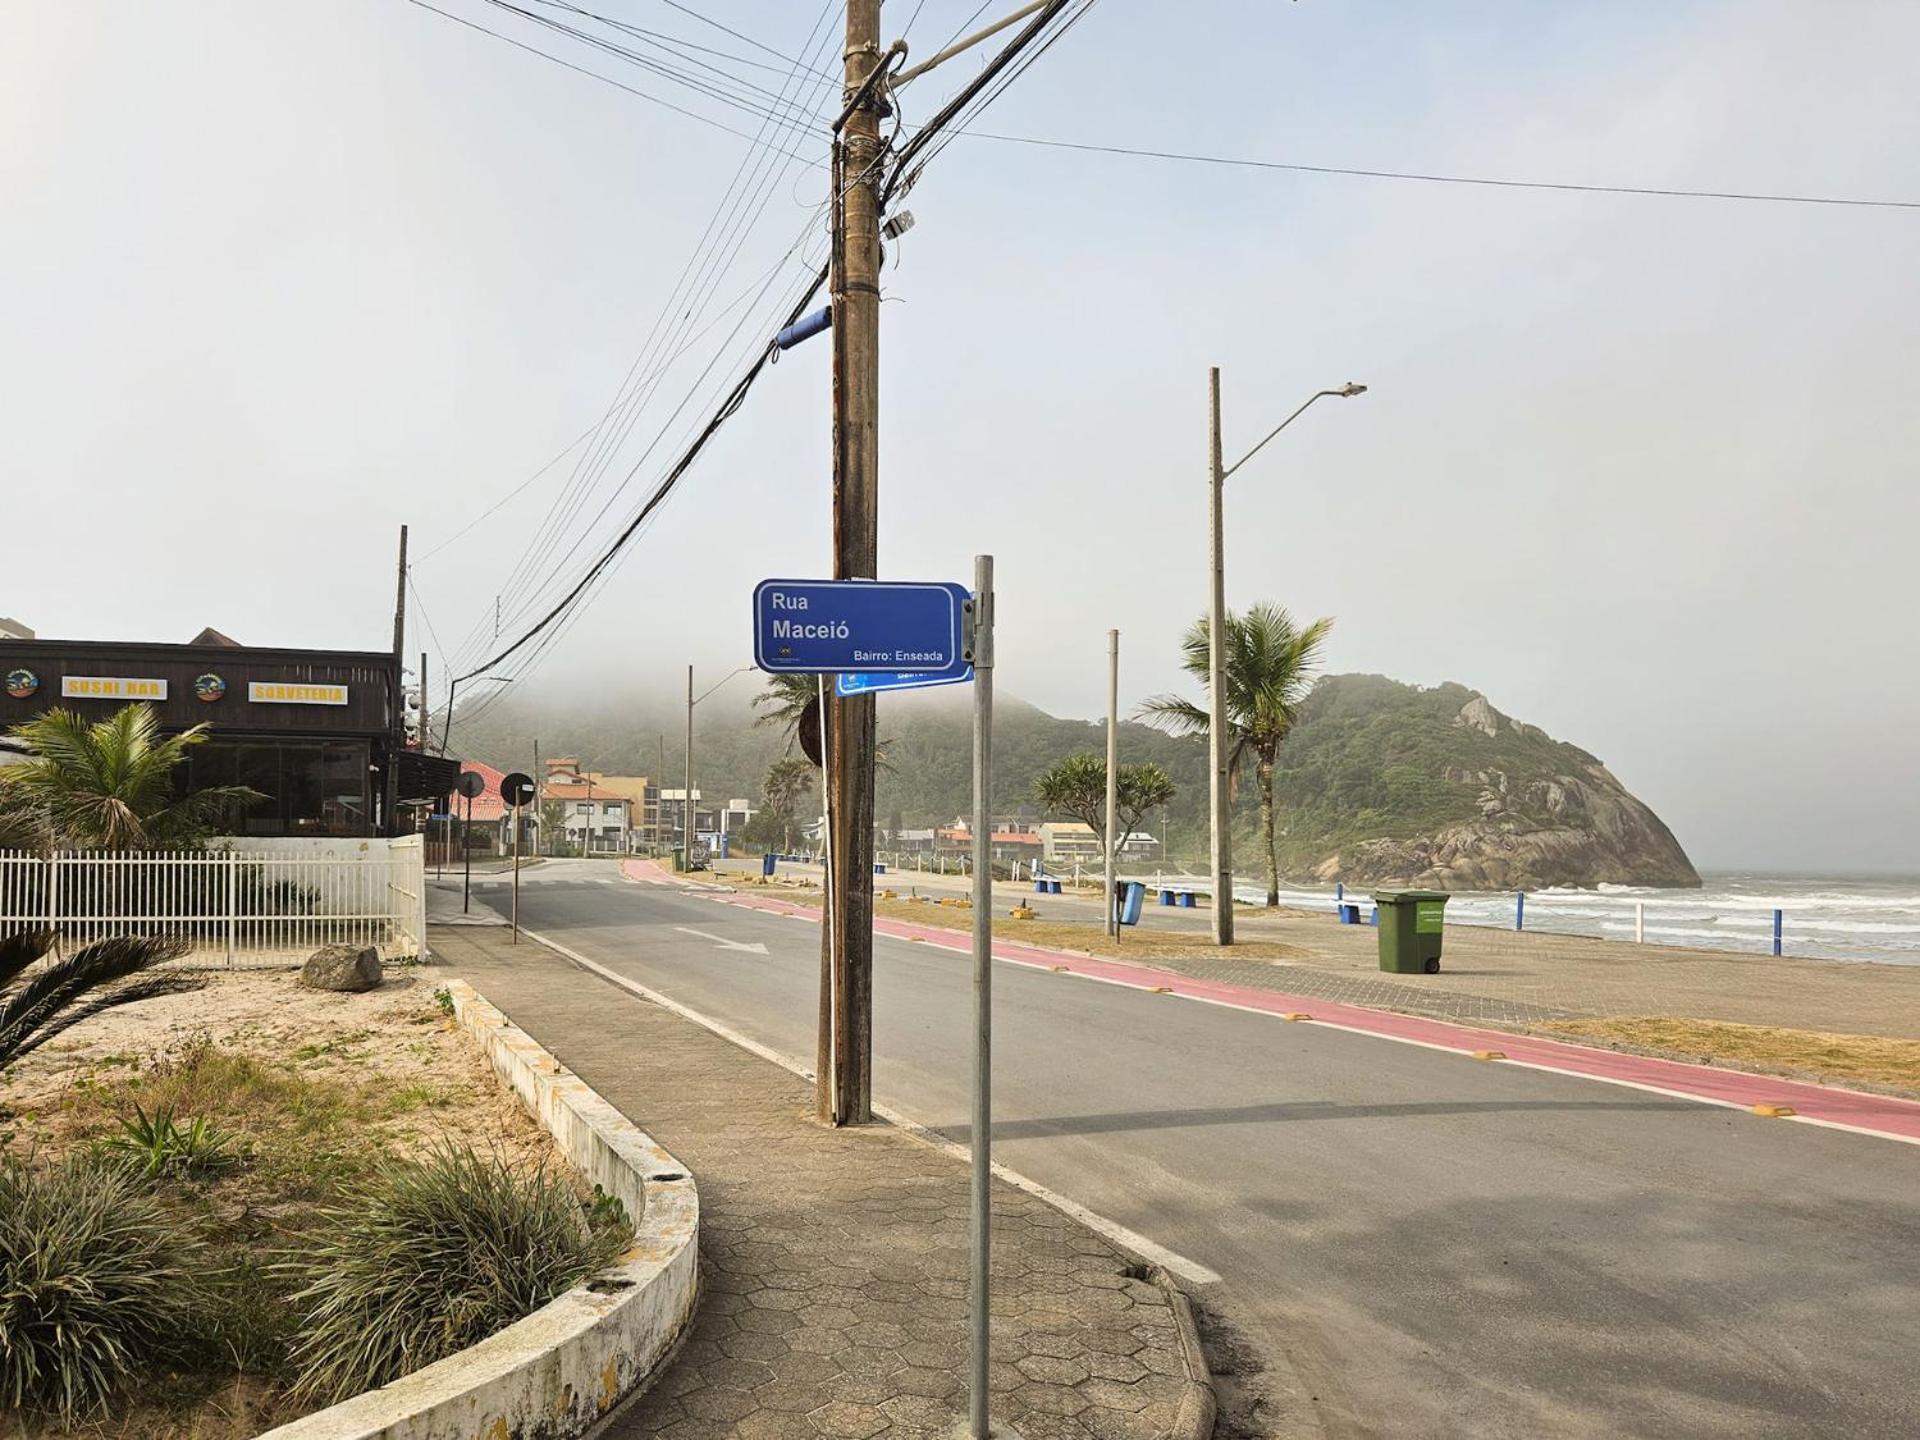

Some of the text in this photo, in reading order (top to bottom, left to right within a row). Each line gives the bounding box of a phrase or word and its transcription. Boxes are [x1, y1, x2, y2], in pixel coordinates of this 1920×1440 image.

[772, 592, 808, 610] Rua
[773, 620, 850, 639] Maceió
[854, 650, 943, 662] Bairro: Enseada
[68, 680, 160, 696] SUSHI BAR
[255, 685, 343, 701] SORVETERIA
